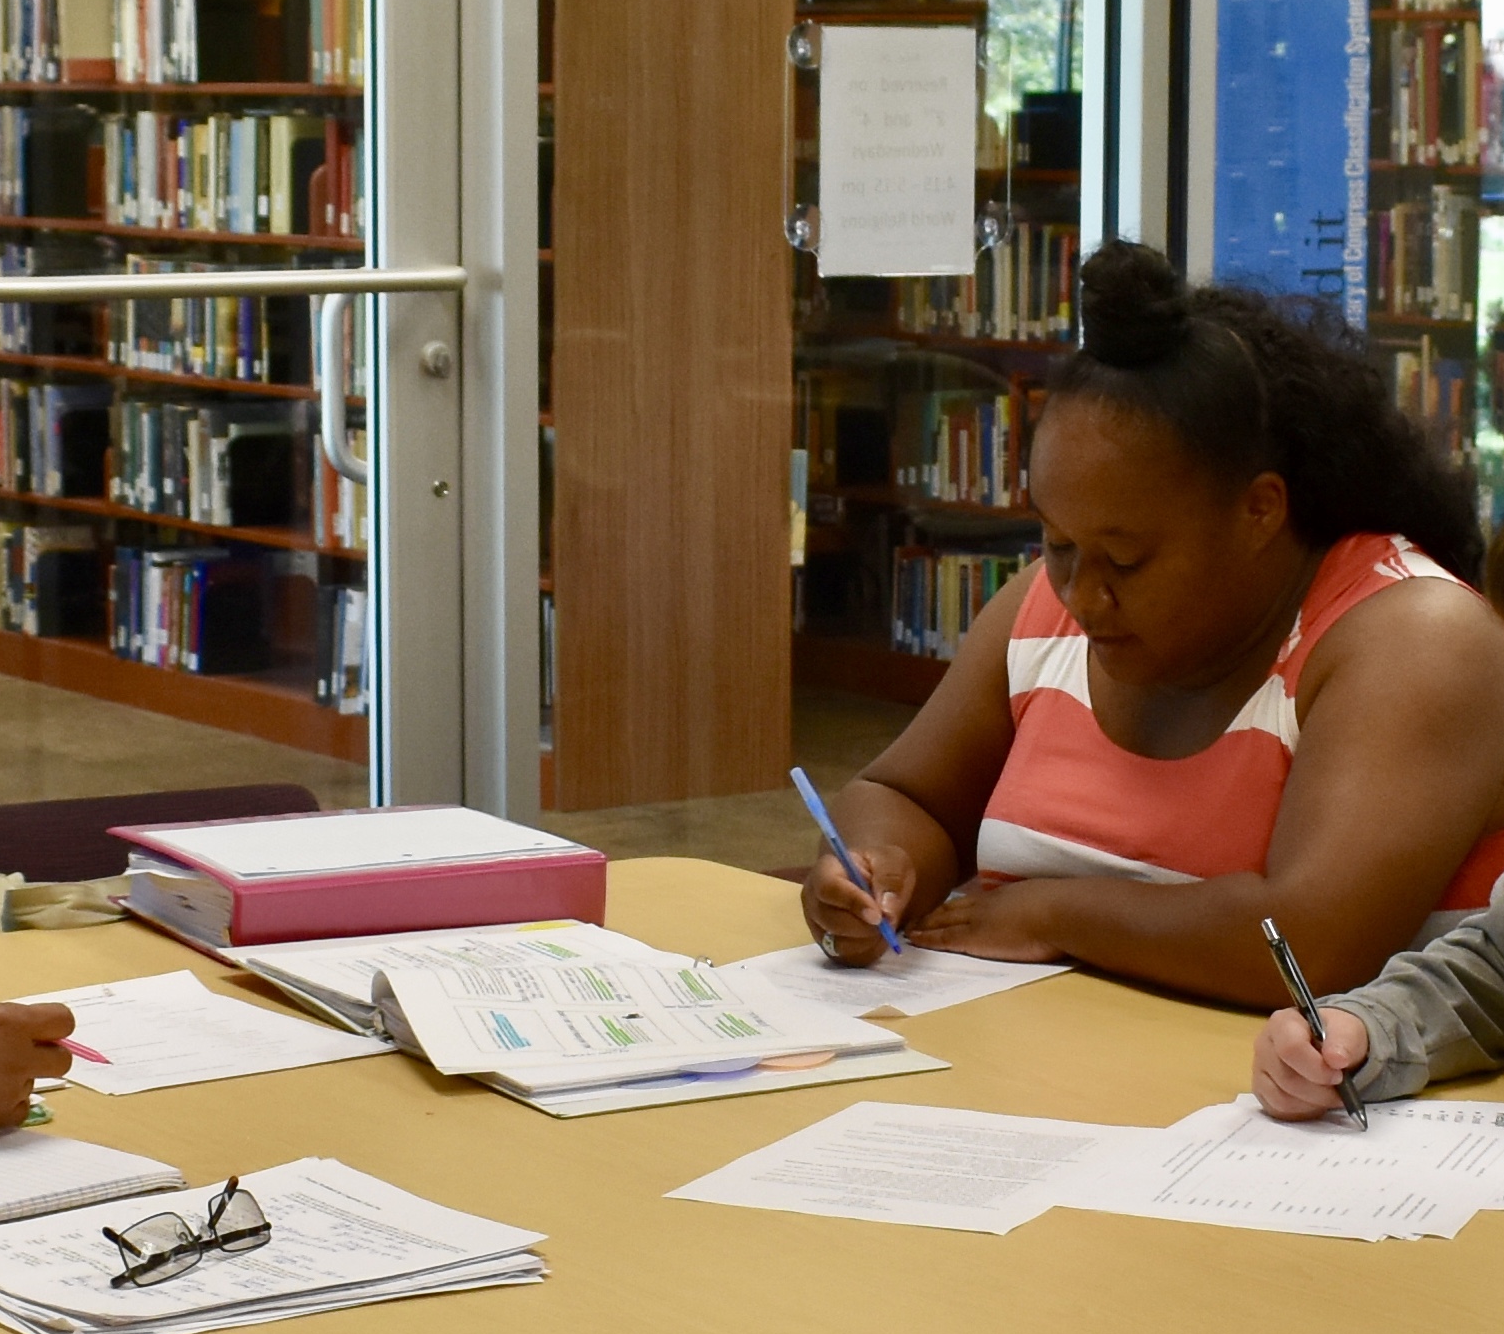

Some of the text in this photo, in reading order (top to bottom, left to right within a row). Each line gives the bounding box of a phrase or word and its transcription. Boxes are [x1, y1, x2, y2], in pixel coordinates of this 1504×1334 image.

[1344, 57, 1369, 176] Classification
[1344, 179, 1367, 261] Congress
[1344, 265, 1367, 284] of
